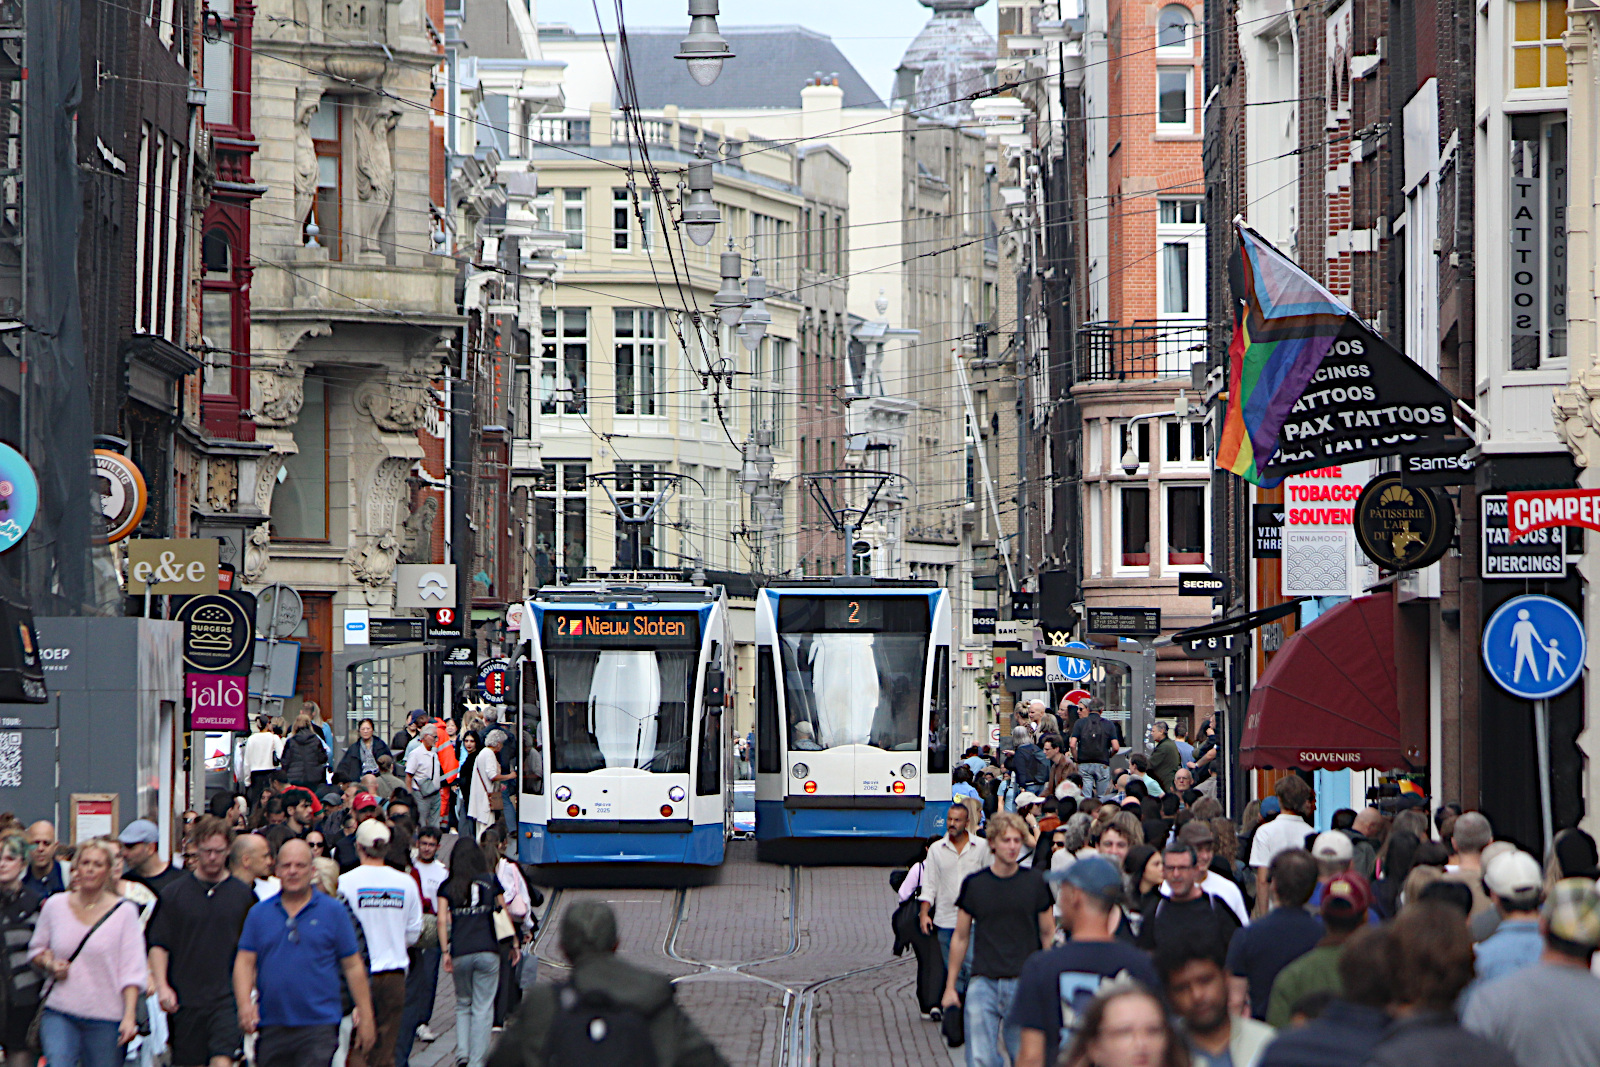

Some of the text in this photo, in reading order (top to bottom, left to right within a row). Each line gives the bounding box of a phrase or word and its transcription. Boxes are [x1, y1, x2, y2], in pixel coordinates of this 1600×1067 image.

[1554, 168, 1564, 316] PIERCING
[1310, 364, 1370, 384] CINGS
[1284, 406, 1447, 441] PAX TATTOOS
[97, 459, 131, 486] WILLIG
[1289, 485, 1364, 501] TOBACCO
[1486, 502, 1508, 516] PAX
[1486, 527, 1561, 544] TATOOS &
[133, 551, 206, 582] e&e
[1488, 556, 1561, 572] PIERCINGS
[1183, 580, 1223, 588] SECRID
[850, 602, 860, 623] 2
[191, 624, 232, 633] BURGERS
[557, 616, 685, 635] 2 Nieuw Sloten
[973, 617, 995, 625] BOSS
[1222, 634, 1234, 649] T
[1010, 665, 1043, 677] RAINS
[191, 679, 243, 714] jalò
[196, 717, 236, 725] JEWELLERY
[1300, 752, 1361, 762] SOUVENIRS
[361, 897, 403, 908] patagonia
